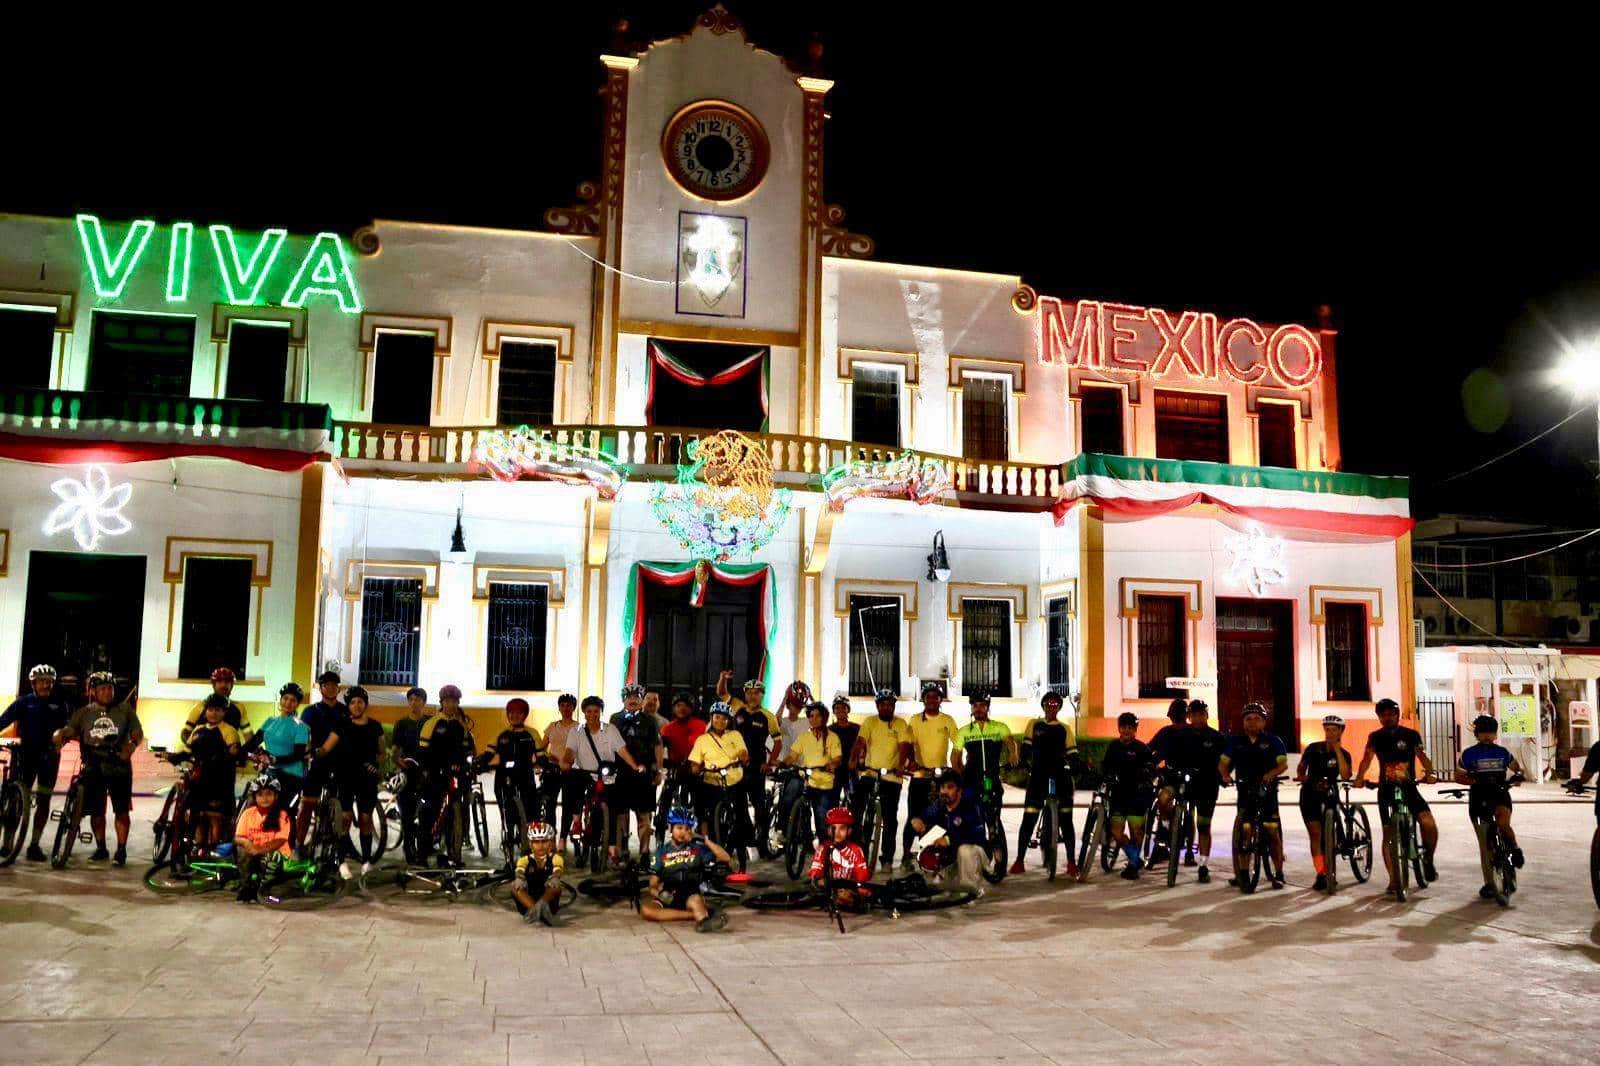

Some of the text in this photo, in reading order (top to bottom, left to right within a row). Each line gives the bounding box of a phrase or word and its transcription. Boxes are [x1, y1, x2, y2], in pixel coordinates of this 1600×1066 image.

[696, 122, 705, 133] 11
[709, 121, 721, 132] 12
[726, 125, 731, 137] 1
[685, 132, 696, 143] 10
[735, 136, 744, 147] 2
[684, 145, 692, 156] 9
[738, 150, 745, 161] 3
[688, 161, 694, 170] 8
[734, 162, 740, 172] 4
[697, 171, 704, 181] 7
[711, 174, 718, 186] 6
[724, 173, 732, 184] 5
[76, 214, 362, 313] VIVA
[1038, 296, 1322, 390] MEXICO
